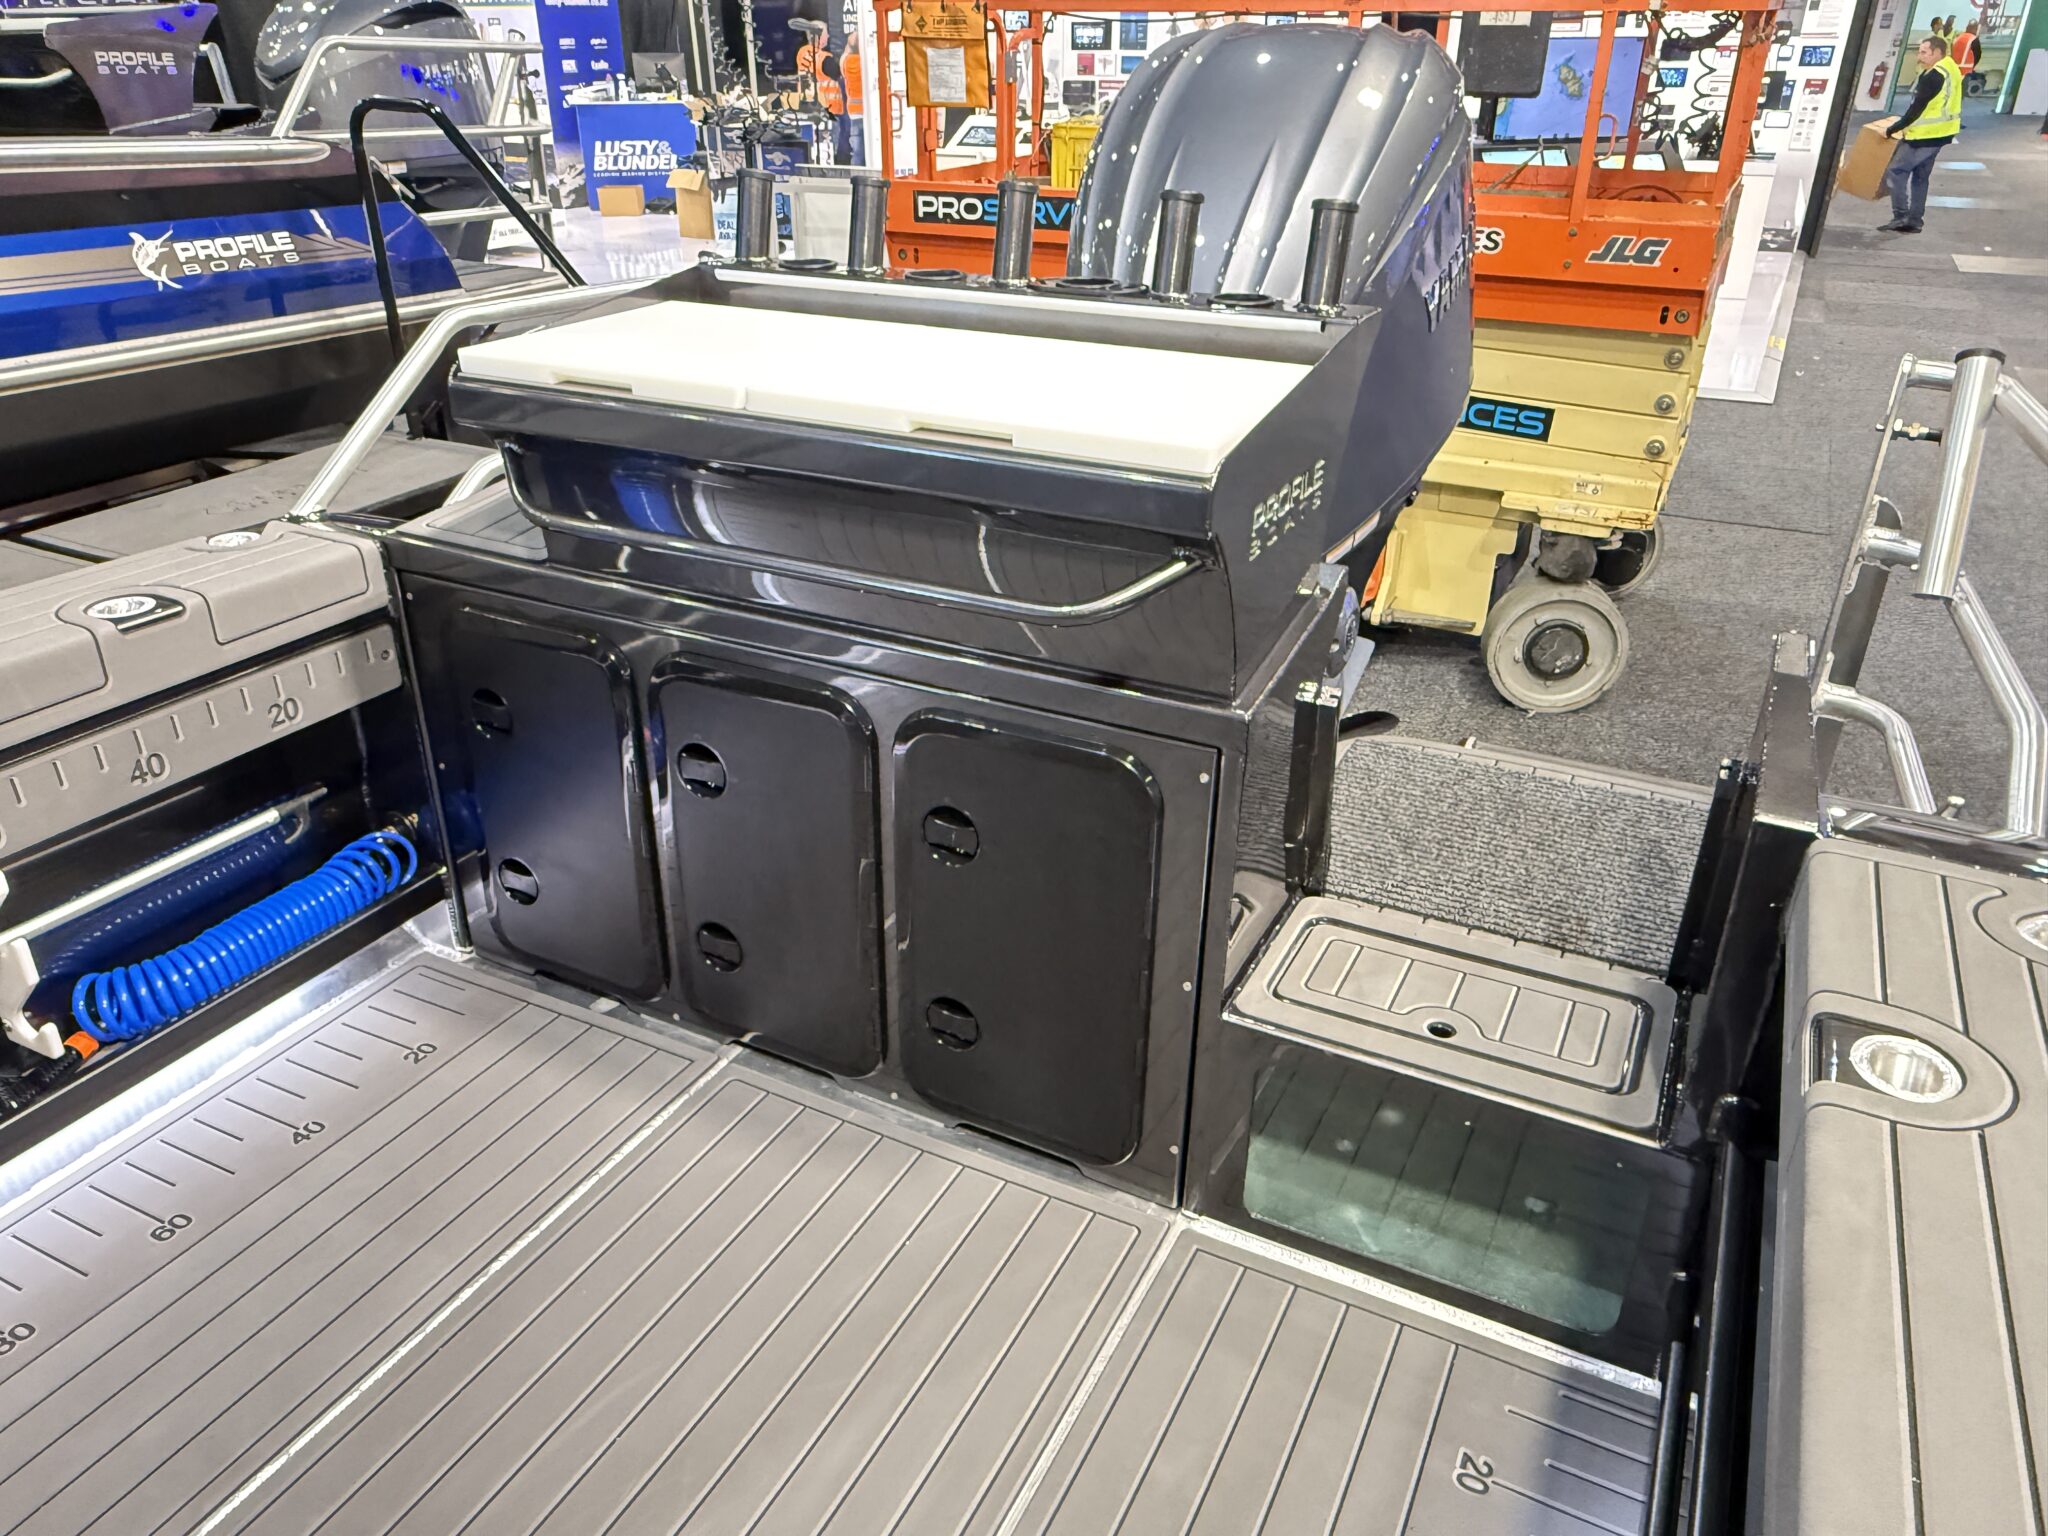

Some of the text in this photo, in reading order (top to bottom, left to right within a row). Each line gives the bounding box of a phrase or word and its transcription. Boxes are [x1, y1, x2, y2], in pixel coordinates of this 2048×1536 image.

[95, 51, 176, 66] PROFILE
[97, 65, 178, 75] BOATS
[173, 231, 295, 263] PROFILE
[1474, 229, 1503, 253] ES
[1585, 235, 1671, 267] JLG
[182, 251, 300, 275] BOATS
[1250, 459, 1325, 538] PROFILE
[268, 696, 300, 731] 20
[130, 751, 169, 786] 40
[402, 1041, 439, 1065] 20
[291, 1120, 327, 1146] 40
[150, 1213, 194, 1242] 60
[1455, 1449, 1495, 1496] 20
